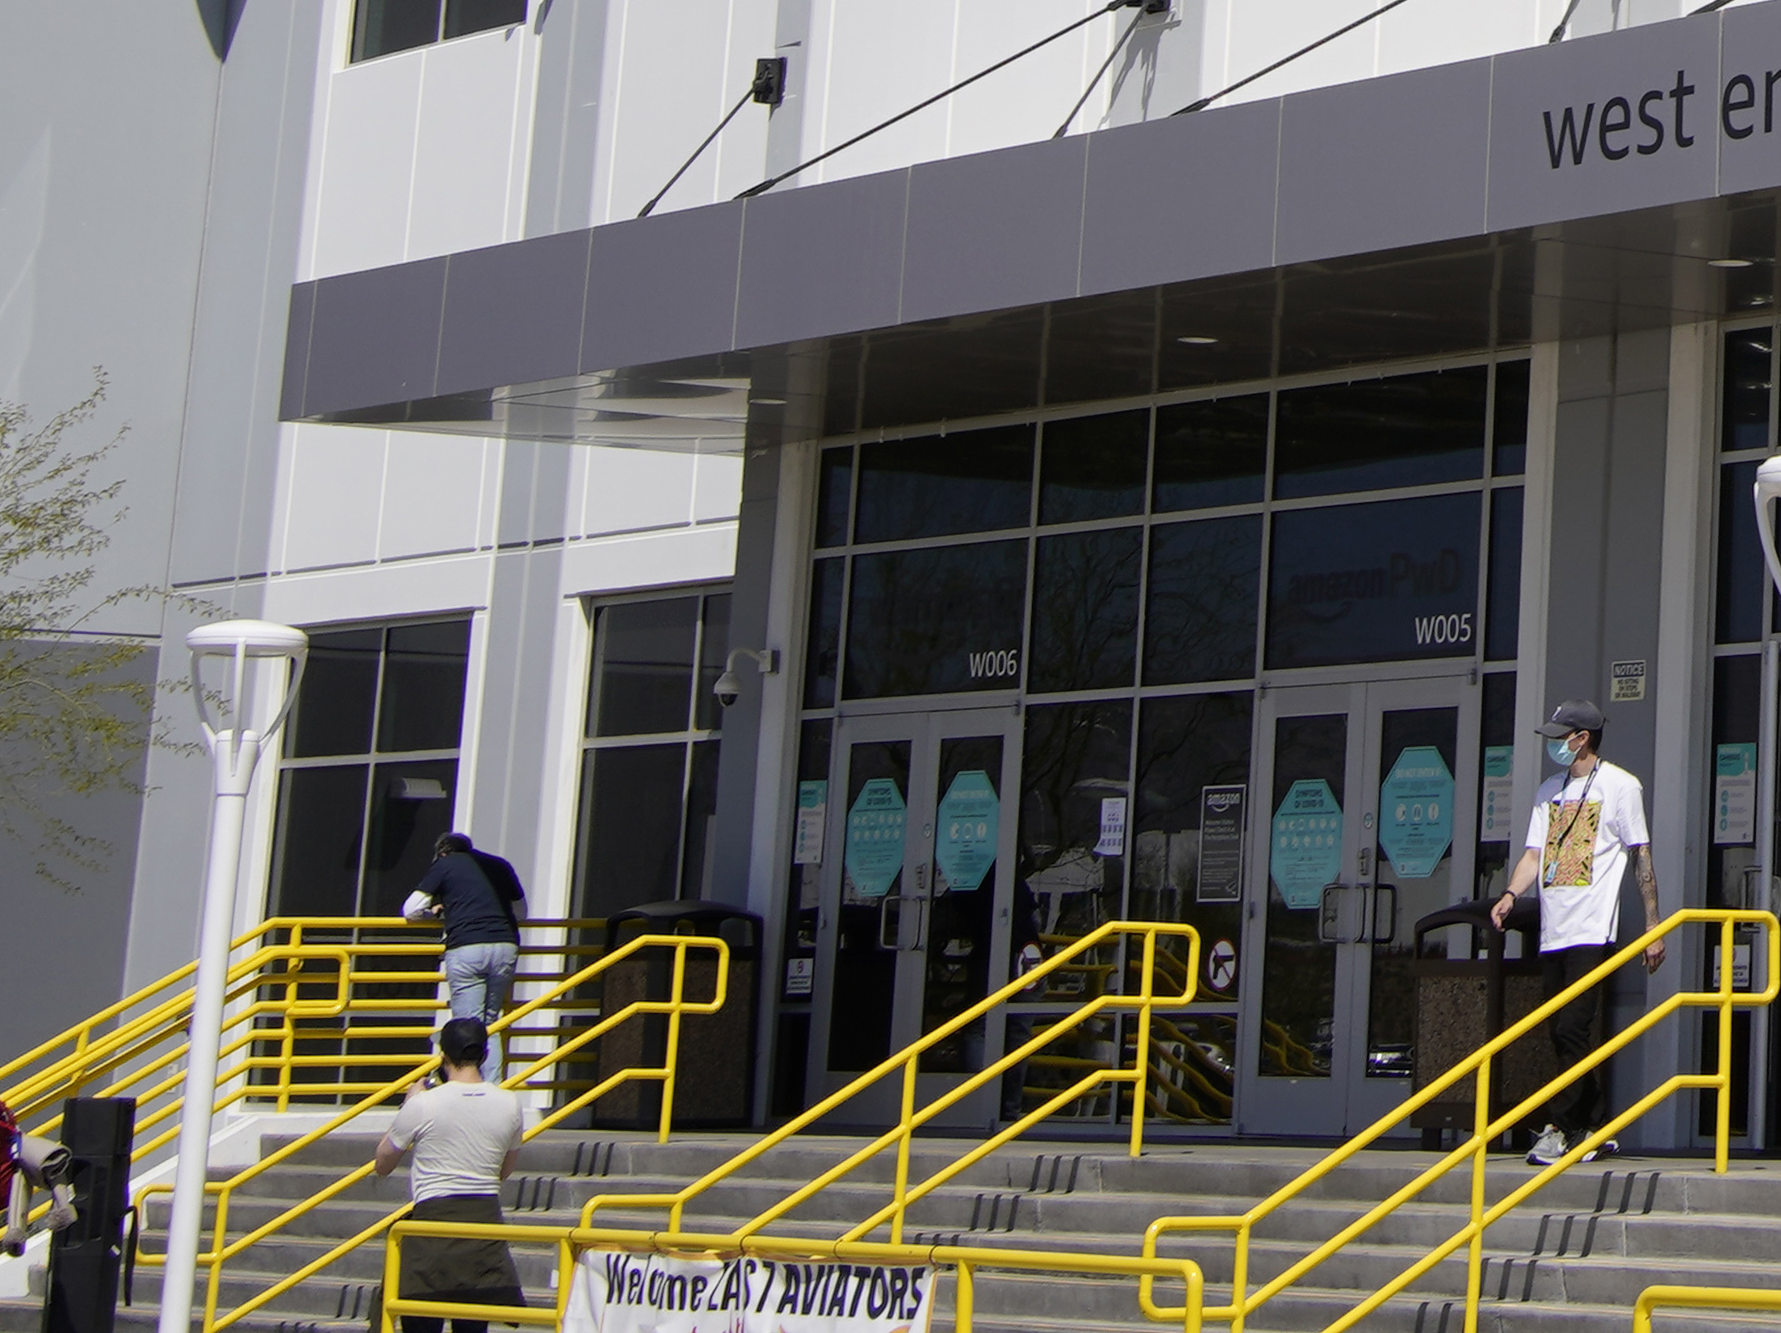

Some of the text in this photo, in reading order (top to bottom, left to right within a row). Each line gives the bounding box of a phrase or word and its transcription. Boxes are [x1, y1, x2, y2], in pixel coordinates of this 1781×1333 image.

[1543, 70, 1695, 169] west
[1415, 613, 1472, 644] W005
[969, 649, 1018, 678] W006
[1614, 664, 1644, 676] NOTICE
[1207, 793, 1240, 806] amazon
[776, 1262, 926, 1320] AVIATORS
